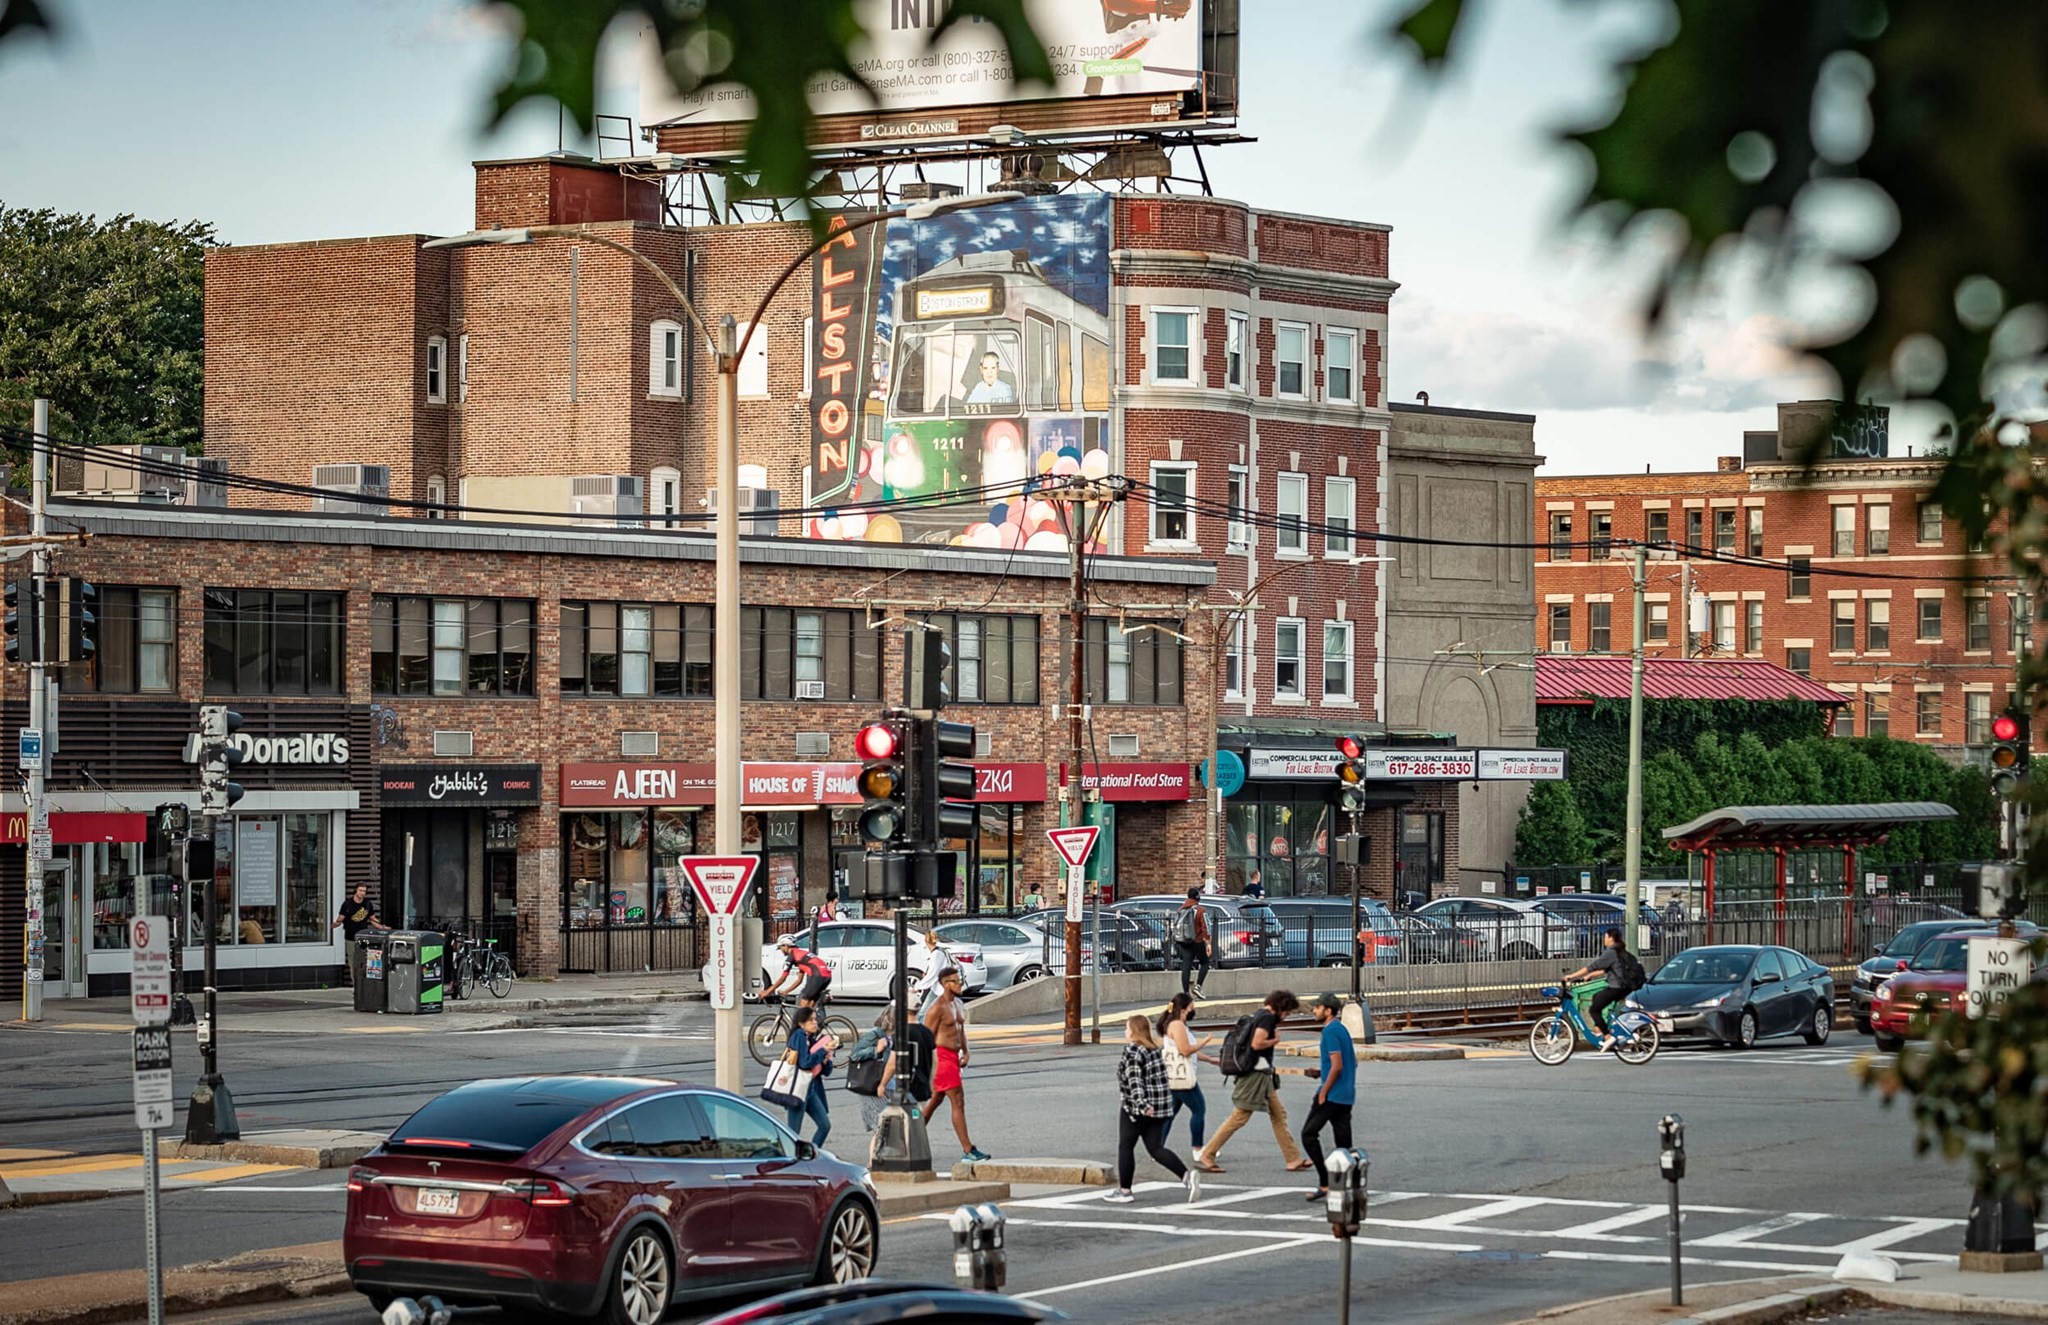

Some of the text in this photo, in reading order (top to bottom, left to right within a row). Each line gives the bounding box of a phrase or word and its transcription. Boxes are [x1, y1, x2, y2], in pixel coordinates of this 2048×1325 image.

[907, 58, 919, 69] or
[921, 53, 940, 67] call
[1049, 44, 1075, 59] 24/7
[682, 93, 704, 106] Play
[707, 91, 715, 102] it
[717, 88, 749, 101] smart
[945, 73, 956, 83] or
[959, 69, 979, 83] call
[818, 214, 858, 473] ALLSTON
[963, 404, 992, 415] 1211
[932, 436, 964, 451] 1211
[184, 733, 350, 764] Donald's
[1389, 763, 1471, 775] 617-286-3830
[383, 771, 531, 799] HOOKAH Habibi's LOUNGE
[570, 779, 606, 787] FLATBREAD
[613, 769, 676, 800] AJEEN
[749, 777, 789, 793] HOUSE
[791, 777, 808, 793] OF
[1133, 774, 1156, 788] Food
[1158, 773, 1183, 787] Store
[490, 823, 518, 838] 1219
[770, 822, 796, 836] 1217
[835, 822, 859, 837] 1215
[709, 885, 733, 895] YIELD
[717, 917, 726, 1005] TO TROLLEY
[1987, 950, 2009, 966] NO
[1979, 970, 2018, 987] TURN
[136, 1031, 168, 1048] PARK
[136, 1048, 170, 1062] BOSTON
[419, 1194, 436, 1207] 4LS
